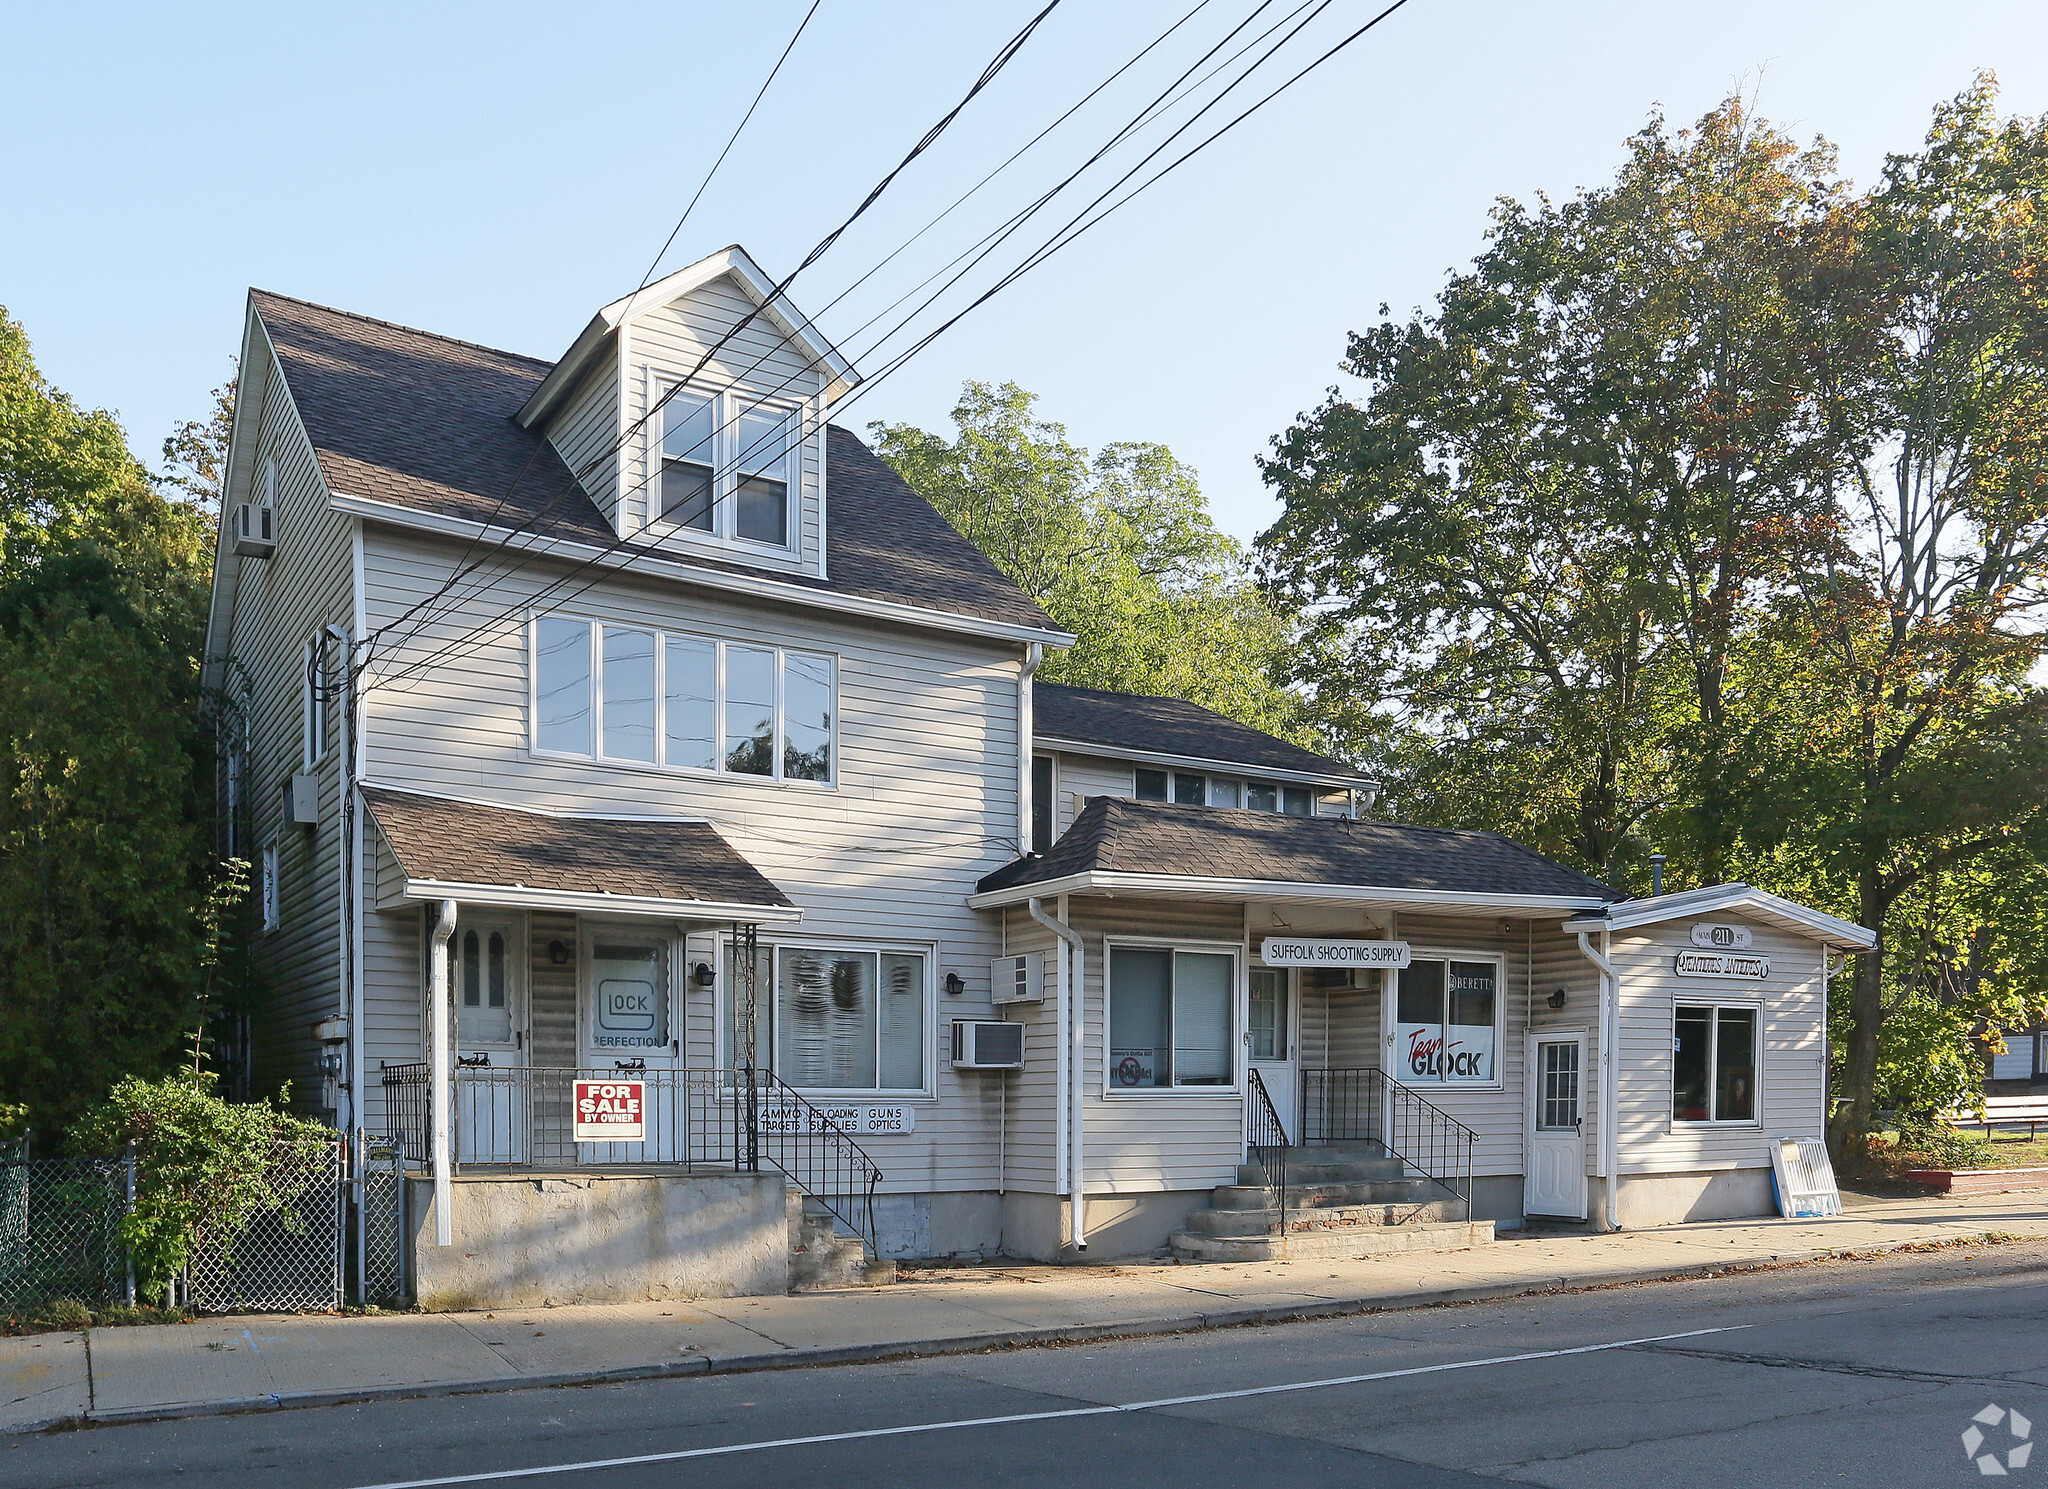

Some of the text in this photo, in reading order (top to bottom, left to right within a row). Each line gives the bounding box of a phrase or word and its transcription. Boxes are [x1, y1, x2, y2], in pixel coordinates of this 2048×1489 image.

[1715, 929, 1730, 945] 211
[1736, 933, 1744, 942] ST
[1271, 944, 1404, 962] SUFFOLK SHOOTING SUPPLY
[1412, 1051, 1481, 1076] GLOCK
[587, 1085, 631, 1099] FOR
[579, 1098, 640, 1113] SALE
[584, 1113, 635, 1123] BY OWNER
[760, 1108, 902, 1119] AMMO RELOADING GUNS
[760, 1119, 902, 1131] TARGETS SUPPLIES OPTICS
